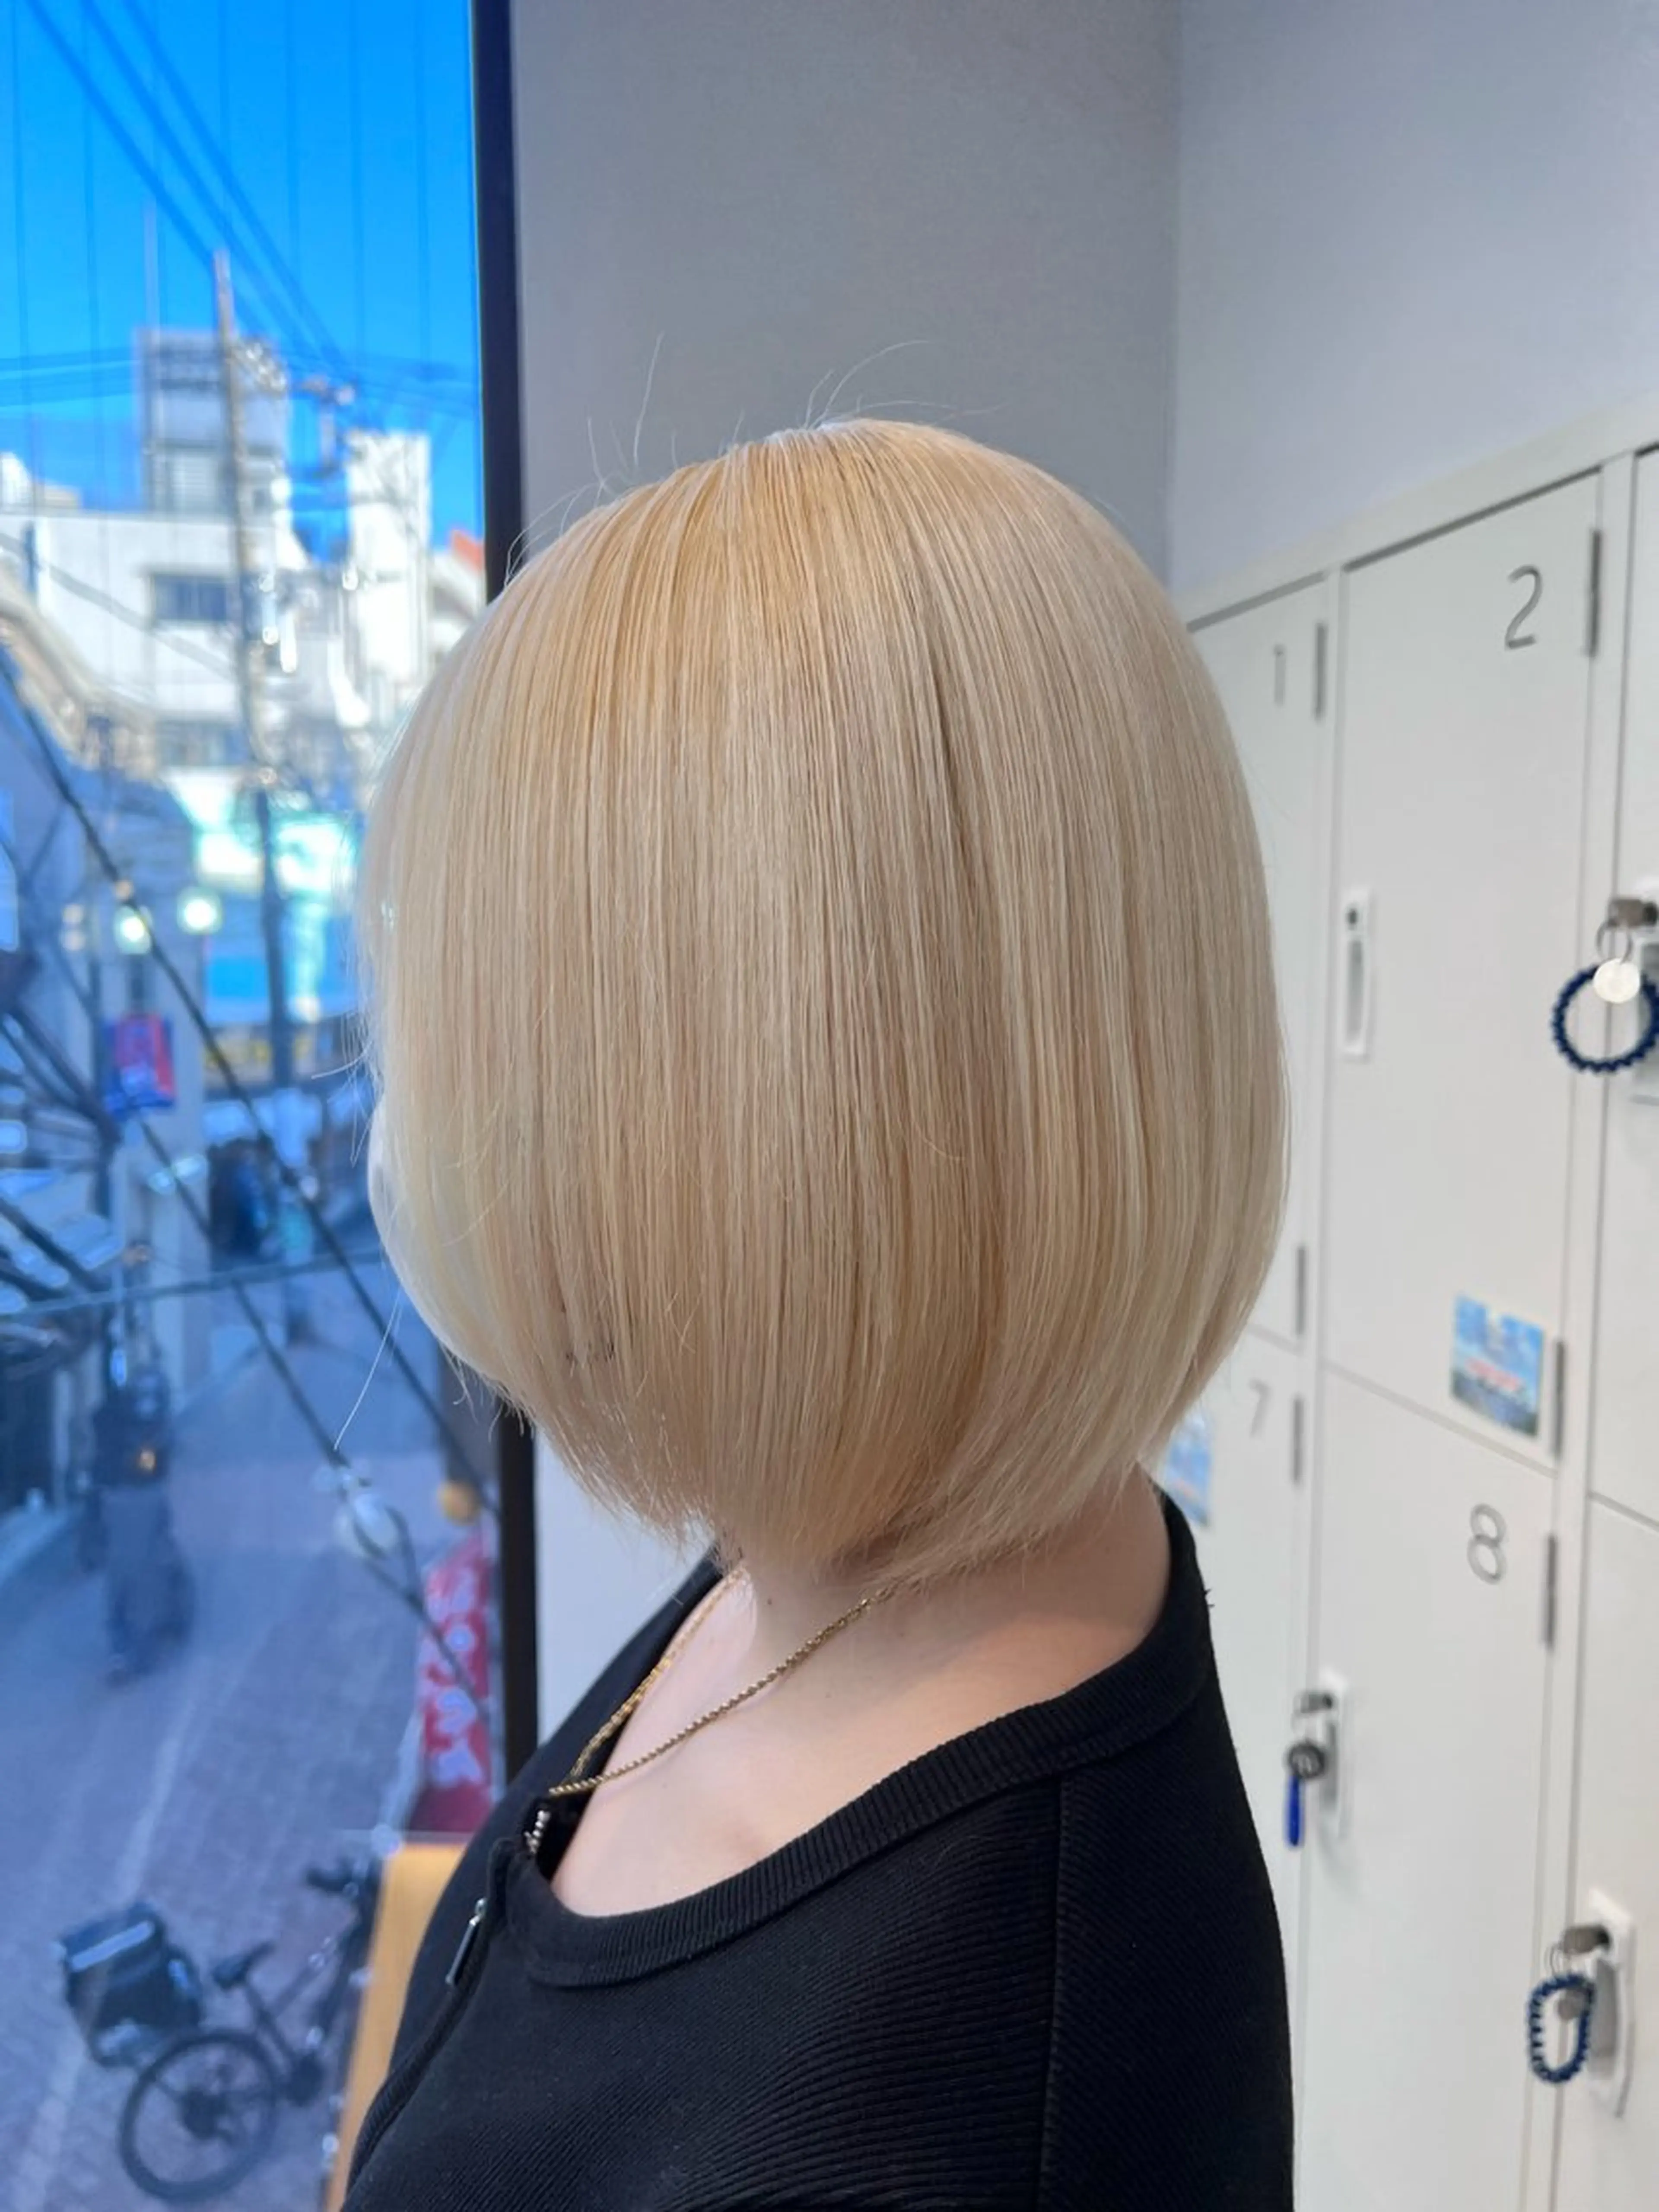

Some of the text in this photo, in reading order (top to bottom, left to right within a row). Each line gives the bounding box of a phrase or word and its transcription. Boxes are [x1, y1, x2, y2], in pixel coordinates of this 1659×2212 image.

[1504, 565, 1542, 650] 2
[1274, 643, 1286, 706] 1
[1248, 1378, 1272, 1438] 7
[1467, 1503, 1508, 1585] 8
